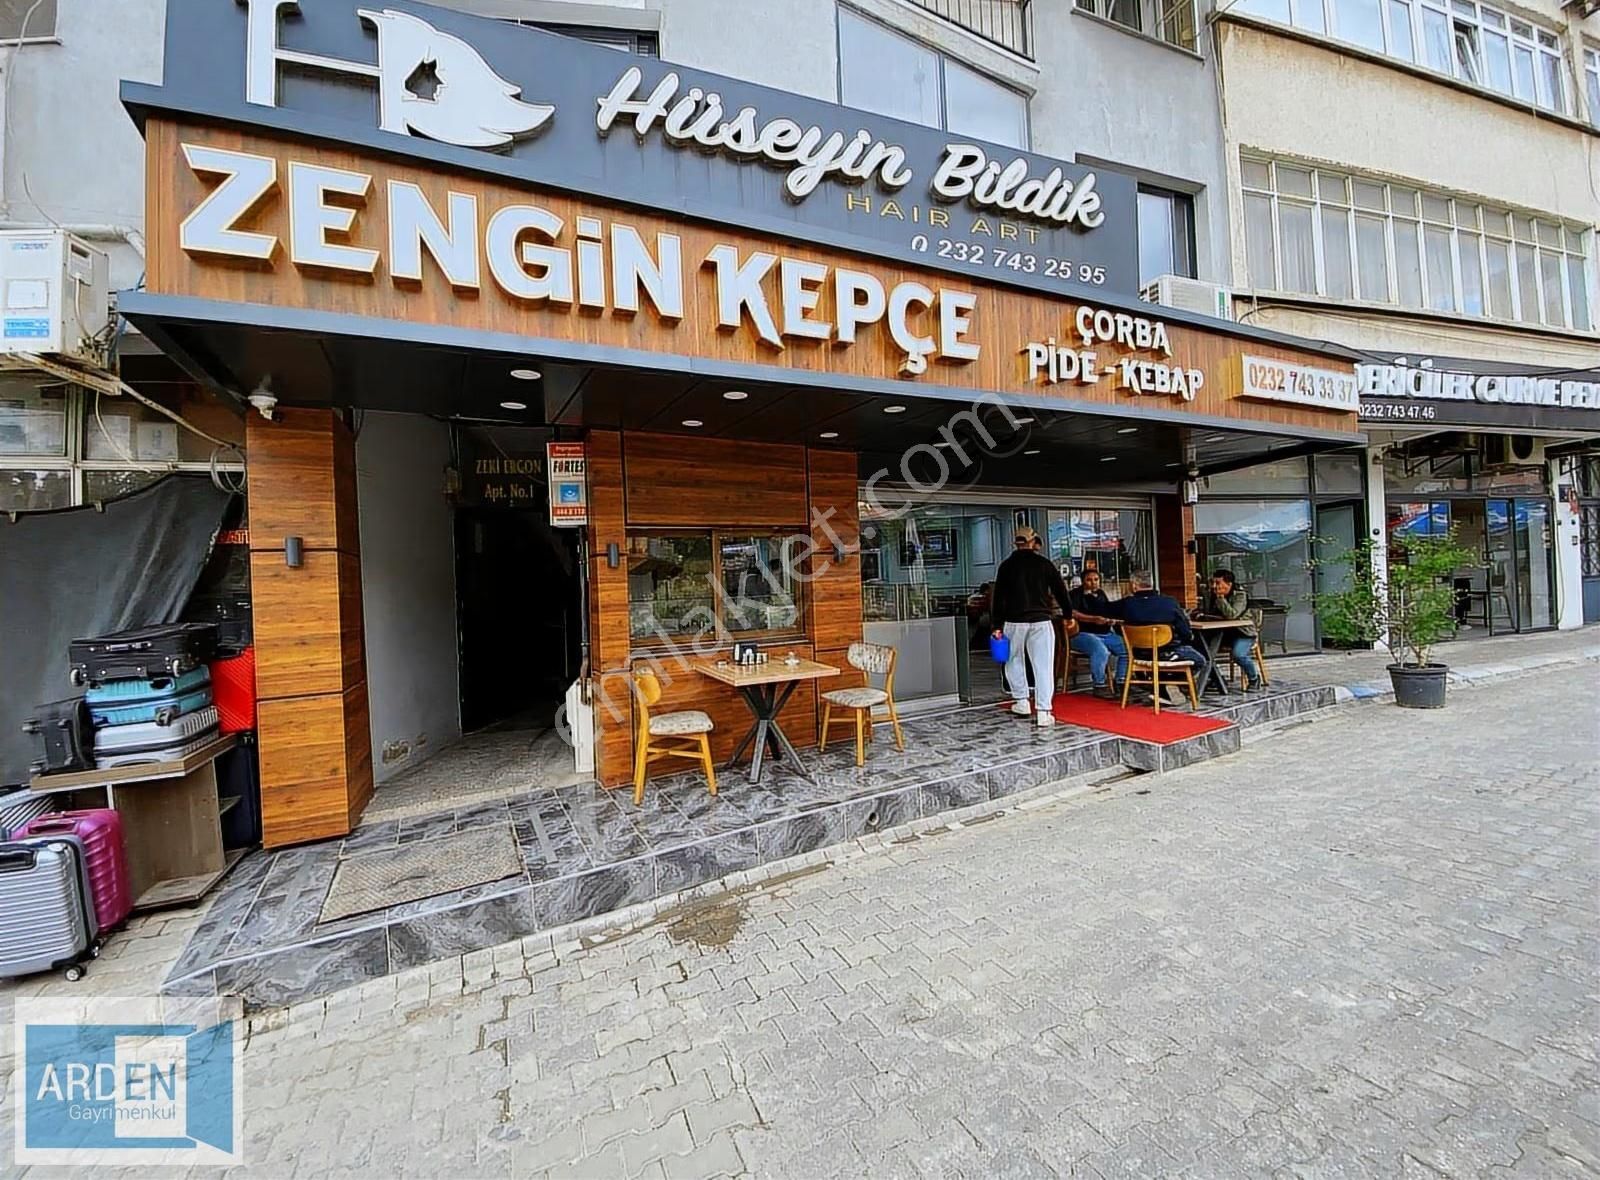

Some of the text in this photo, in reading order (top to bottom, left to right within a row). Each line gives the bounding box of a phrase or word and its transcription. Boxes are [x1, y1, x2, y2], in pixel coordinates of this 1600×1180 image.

[596, 65, 1106, 229] Hüseyin Bildik
[847, 193, 1040, 245] HAIR ART
[937, 240, 984, 265] 232
[992, 249, 1036, 273] 743
[1044, 258, 1072, 279] 25
[1078, 265, 1106, 285] 95
[703, 244, 981, 375] KEPÇE
[1075, 305, 1173, 357] ÇORBA
[1027, 337, 1099, 383] PİDE
[1121, 358, 1204, 401] KEBAP
[1249, 363, 1285, 391] 0232
[1289, 371, 1315, 397] 743
[1319, 376, 1335, 399] 33
[1358, 403, 1384, 418] 0232
[1387, 404, 1406, 418] 743
[1407, 406, 1420, 418] 47
